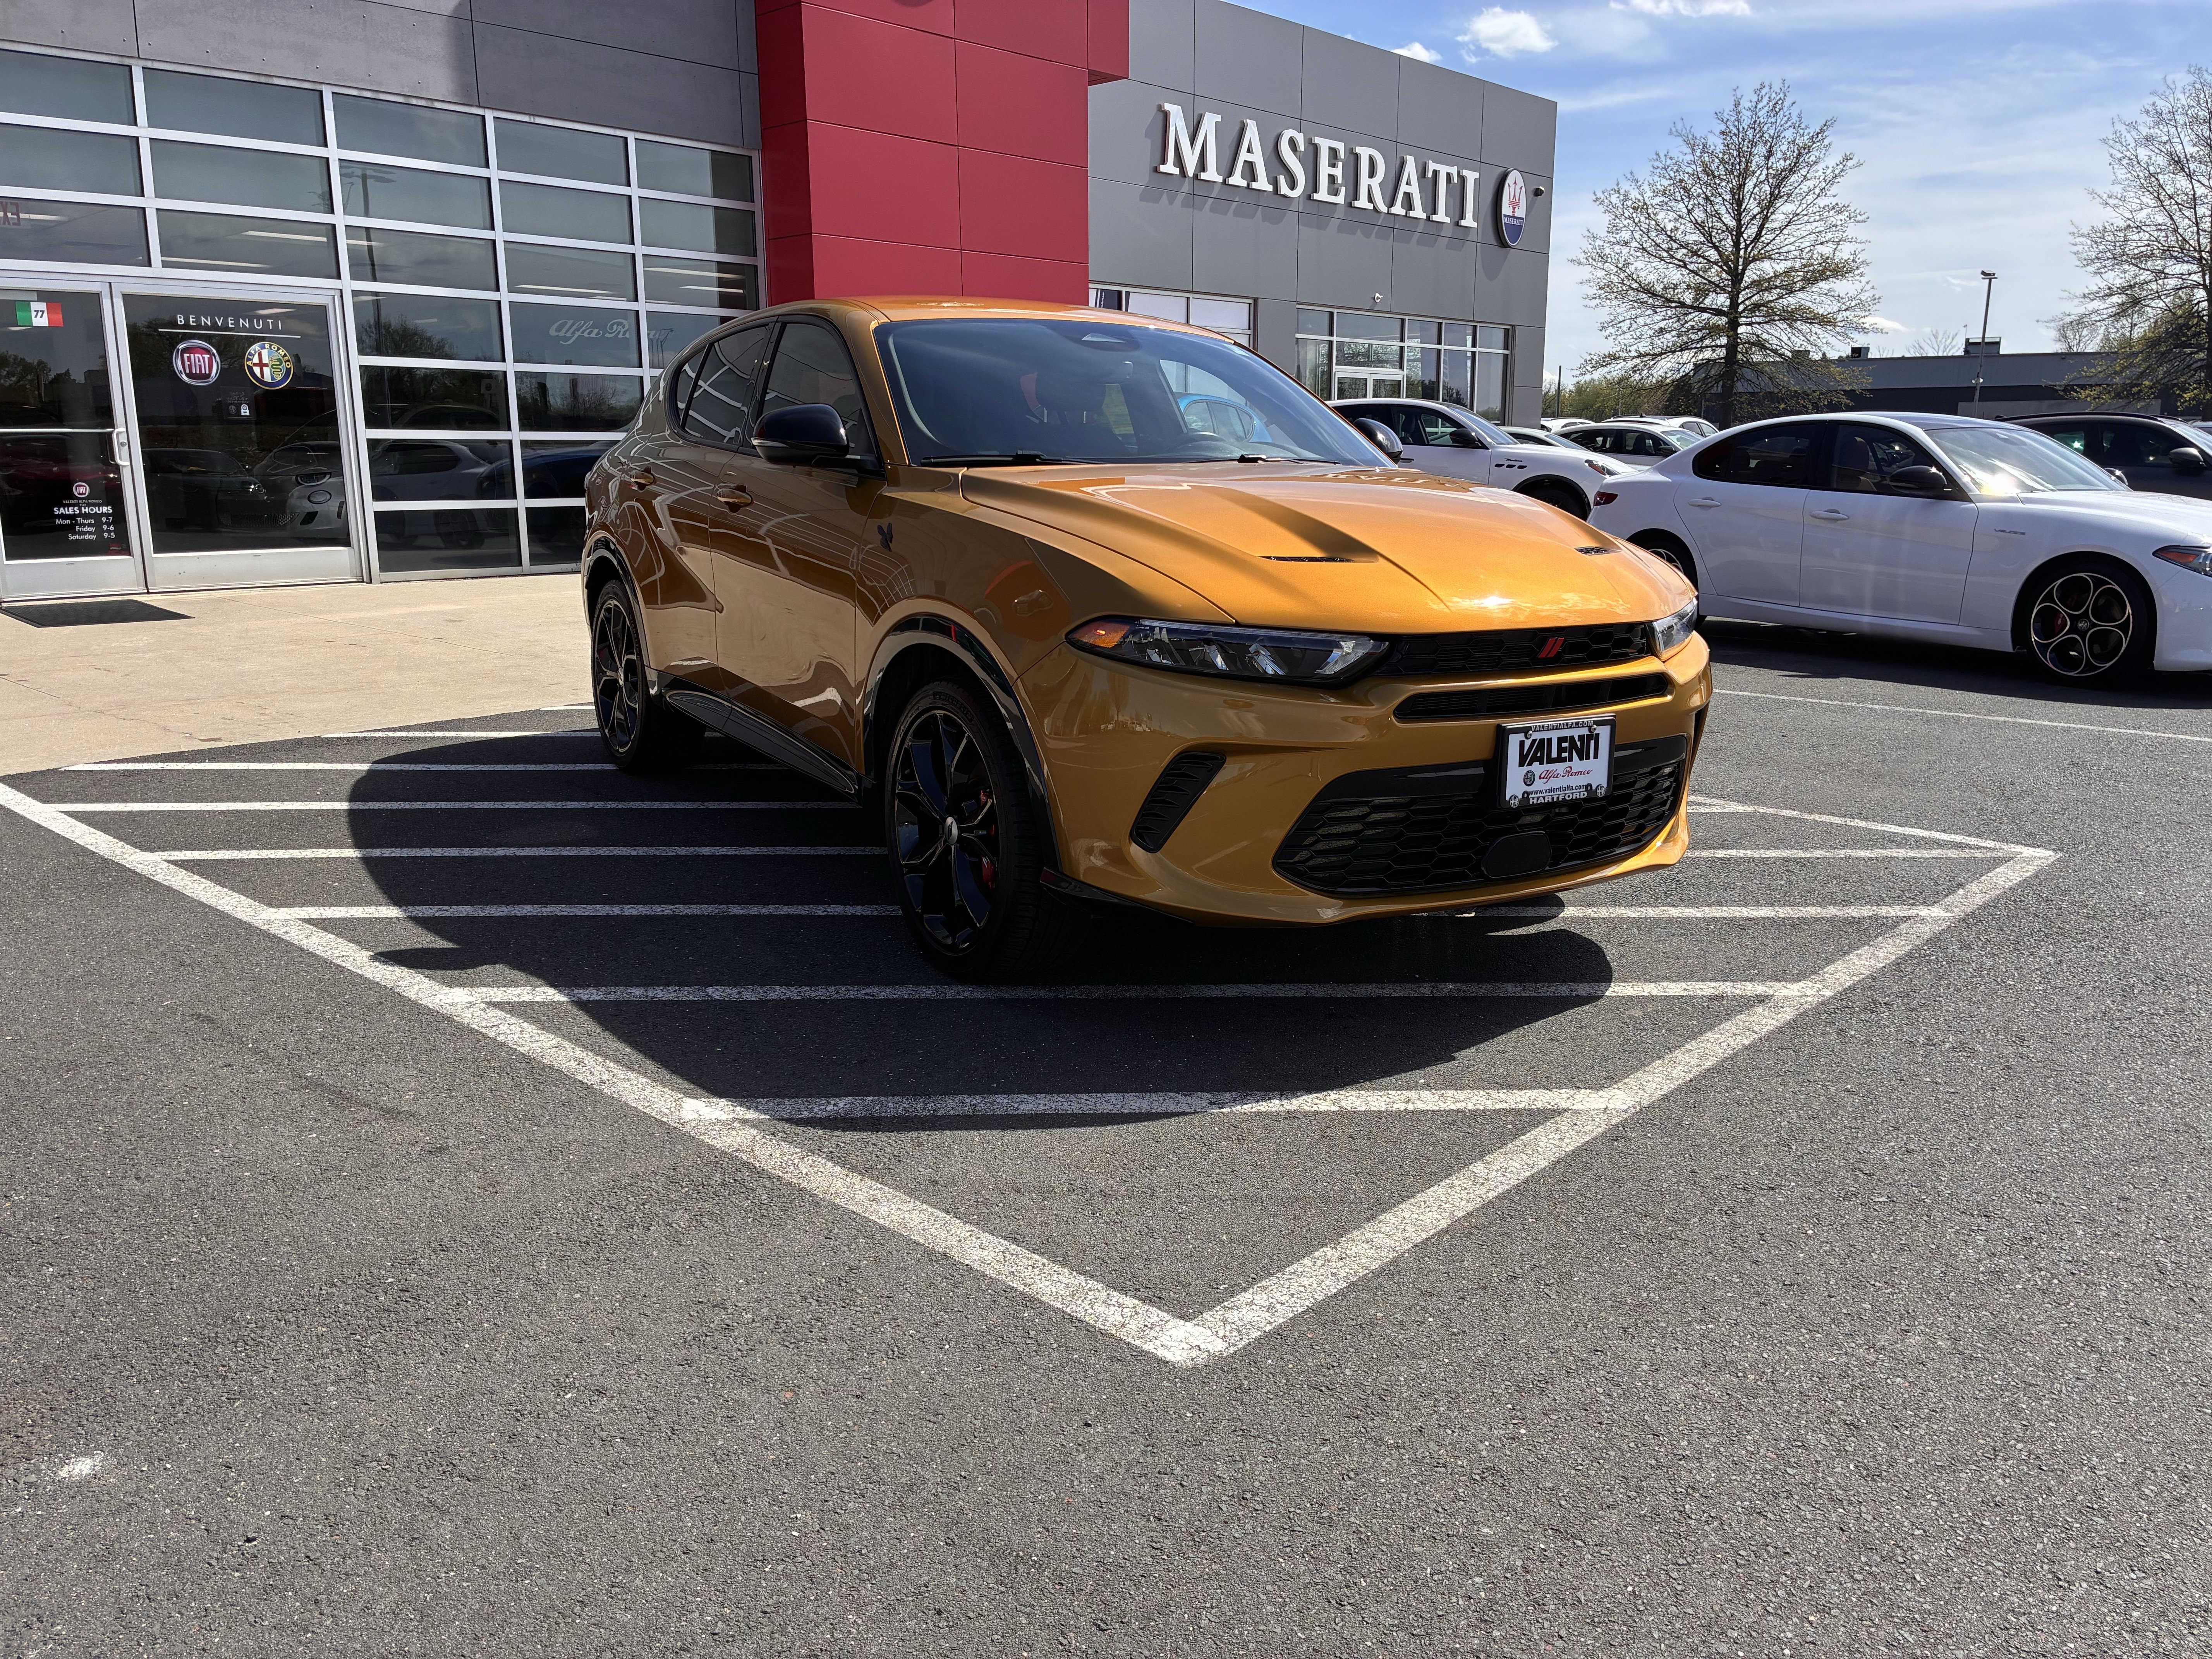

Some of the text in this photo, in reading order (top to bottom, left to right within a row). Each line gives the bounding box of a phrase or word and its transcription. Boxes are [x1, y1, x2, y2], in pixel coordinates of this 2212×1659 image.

[1157, 102, 1480, 228] MASERATI
[1504, 216, 1523, 226] MASERATI
[34, 310, 45, 319] 77
[177, 314, 281, 330] BENVENUTI
[549, 319, 603, 345] Alfa
[183, 353, 210, 374] FIAT
[247, 343, 291, 368] ALFA ROMEO
[1531, 720, 1594, 732] VALENTIALFA.COM
[1518, 733, 1600, 768] VALENTI
[1539, 769, 1561, 784] Alfa
[1562, 766, 1593, 778] Romeo
[1529, 784, 1587, 796] www.valentialfa.com
[1529, 791, 1587, 804] HARTFORD
